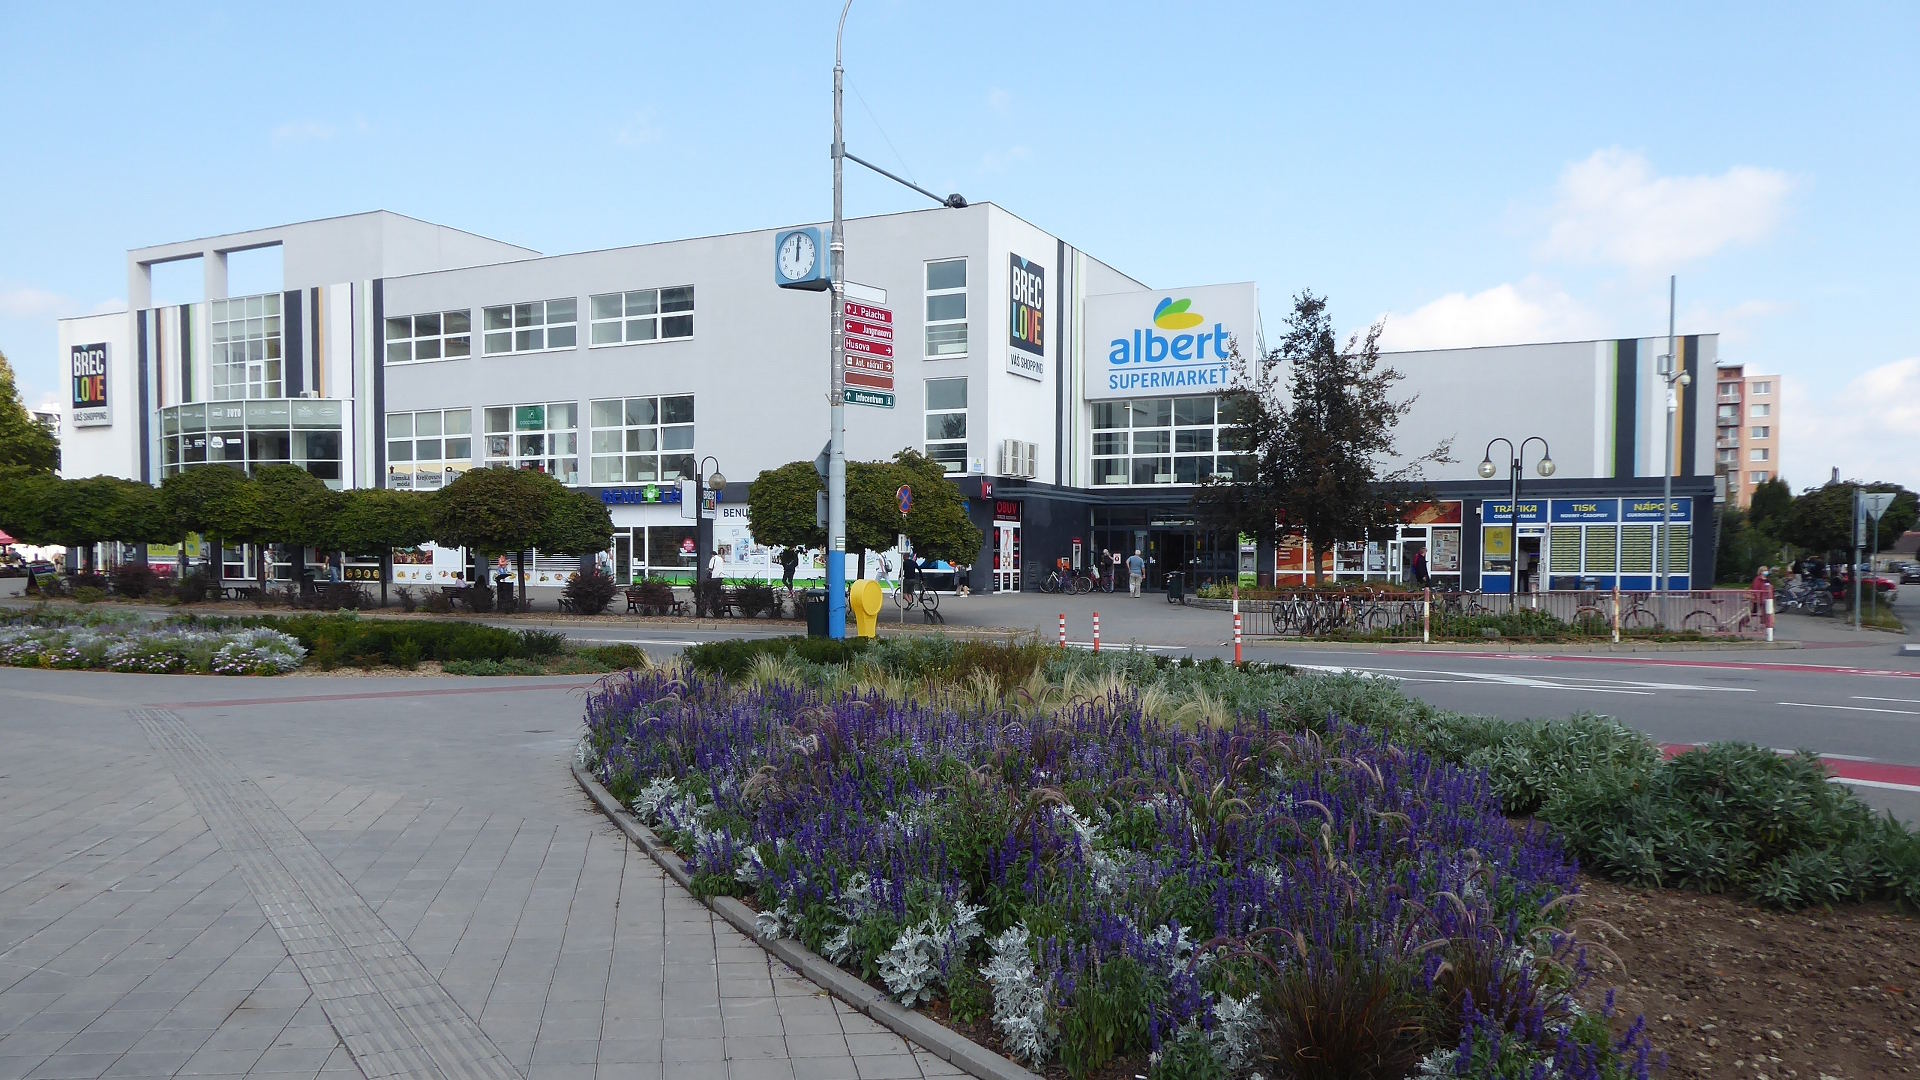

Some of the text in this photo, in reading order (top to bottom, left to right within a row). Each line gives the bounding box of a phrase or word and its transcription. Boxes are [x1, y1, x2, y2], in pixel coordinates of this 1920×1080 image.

[853, 305, 886, 321] J. Palacha
[1012, 301, 1042, 346] LOVE
[846, 339, 870, 352] Husova
[1109, 323, 1229, 365] albert
[1020, 358, 1044, 374] SHOPPING
[1109, 368, 1229, 390] SUPERMARKET
[74, 375, 105, 402] LOVE
[855, 392, 884, 405] Infocentrum
[724, 508, 748, 518] BENU
[996, 501, 1017, 515] OBUV
[1493, 504, 1538, 513] TRAIKA
[1572, 504, 1597, 512] TISK
[1633, 501, 1679, 511] NÁPOE
